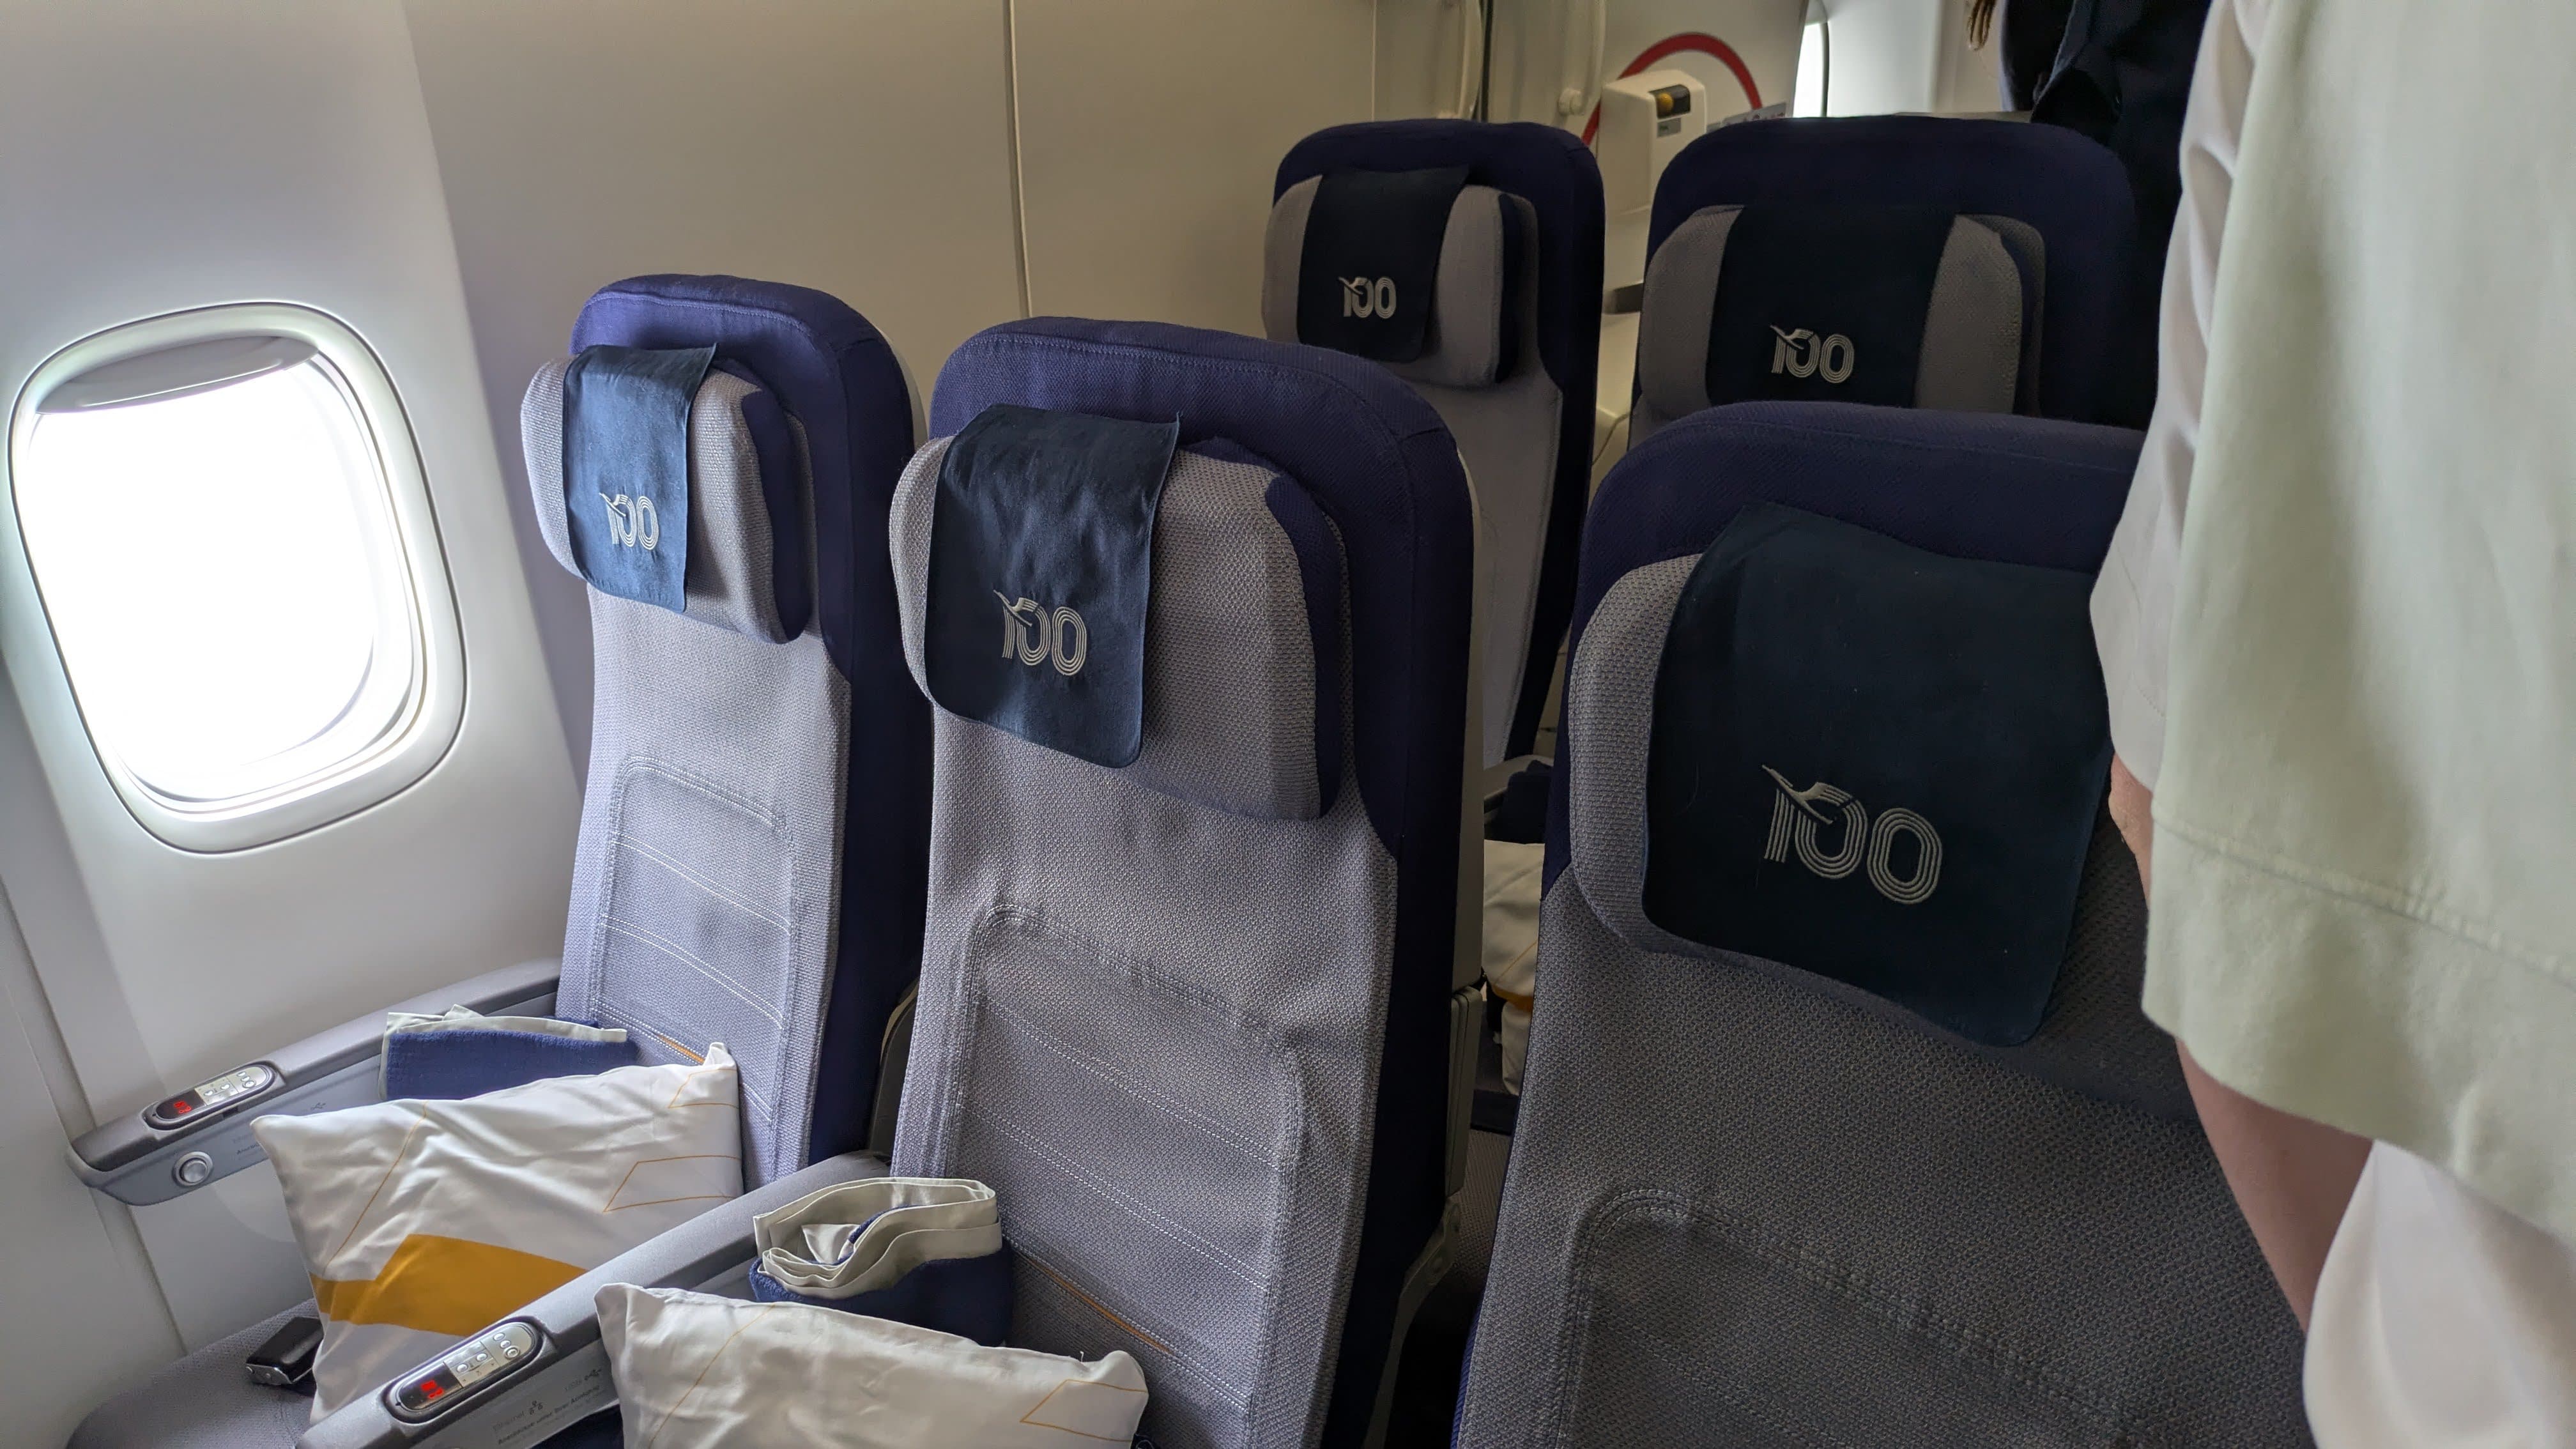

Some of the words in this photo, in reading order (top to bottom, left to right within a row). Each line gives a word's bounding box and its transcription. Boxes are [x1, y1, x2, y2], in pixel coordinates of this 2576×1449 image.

[1338, 277, 1397, 319] 100
[1770, 325, 1855, 383] 100
[599, 493, 659, 550] 100
[993, 589, 1087, 676] 100
[1762, 764, 1943, 905] 100
